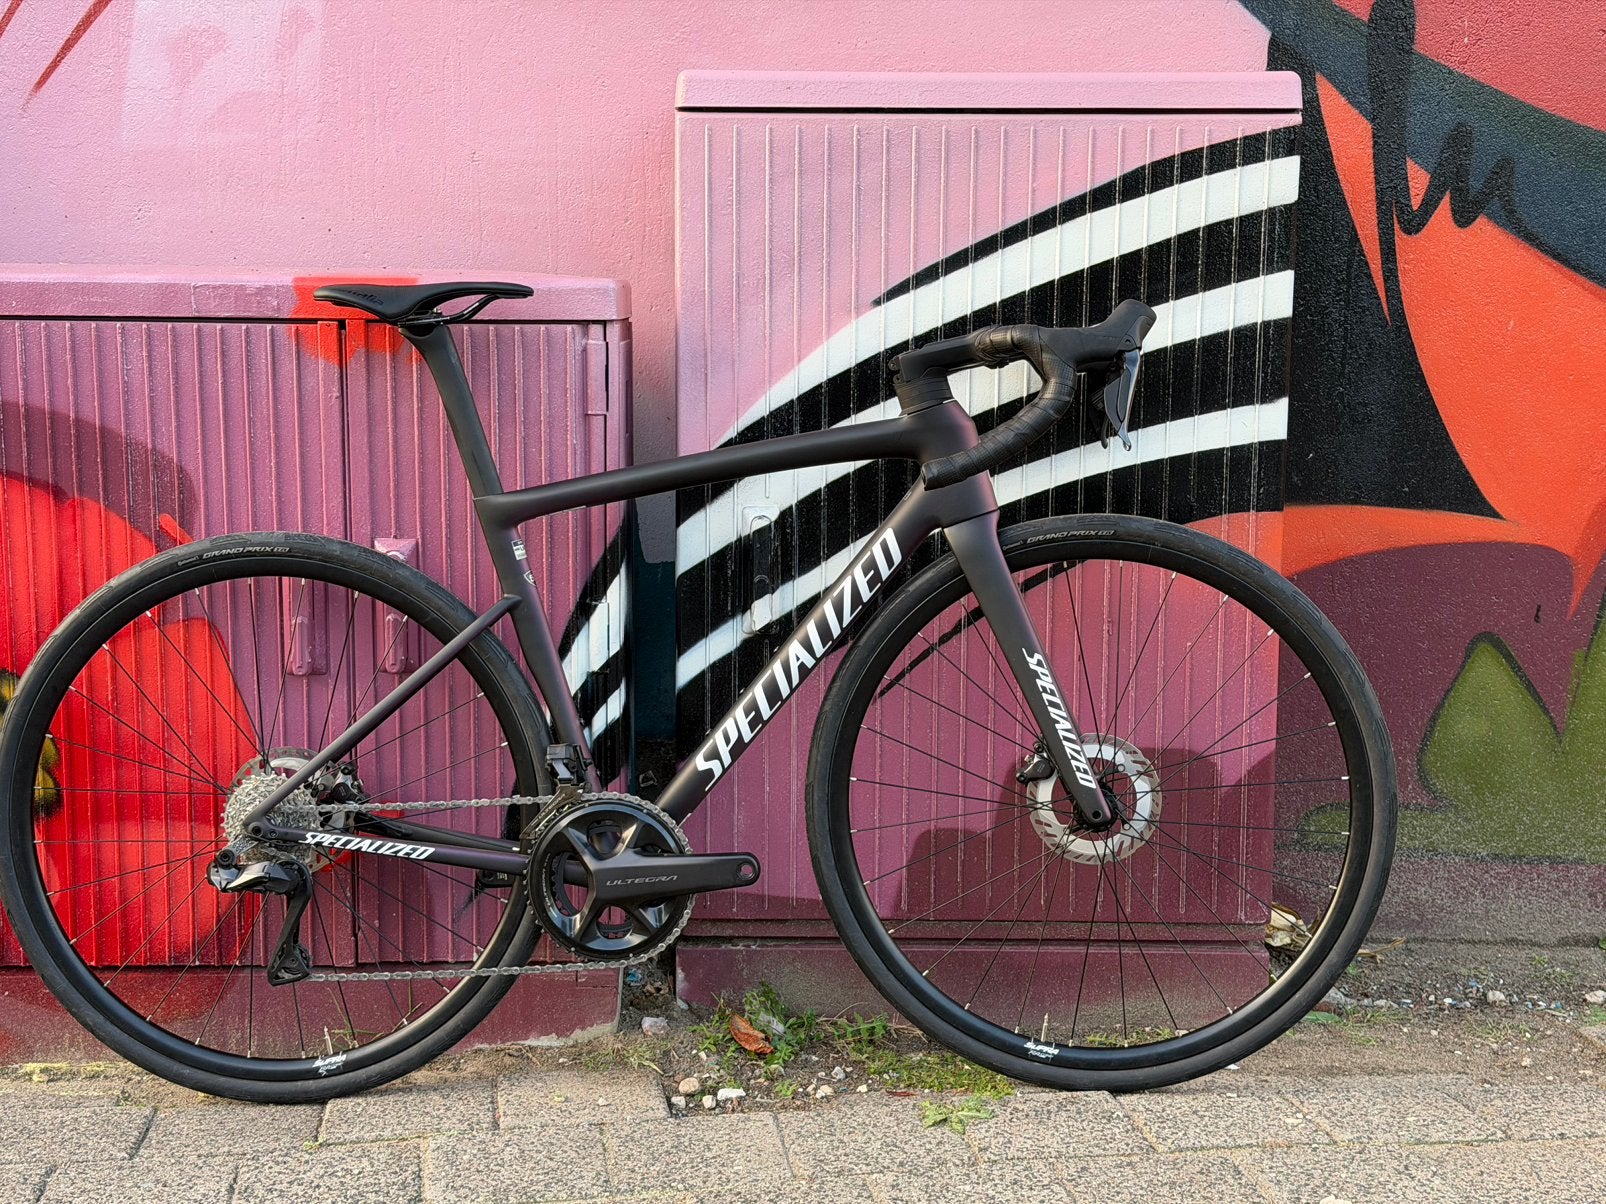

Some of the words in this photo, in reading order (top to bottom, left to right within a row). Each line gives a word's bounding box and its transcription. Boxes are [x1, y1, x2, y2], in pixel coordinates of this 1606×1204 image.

[1026, 531, 1068, 544] GRAND
[202, 547, 243, 559] GRAND
[694, 527, 902, 792] SPECIALIZED
[1021, 647, 1097, 789] SPECIALIZED
[297, 831, 436, 860] SPECIALIZED
[606, 875, 678, 886] ULTEGRA
